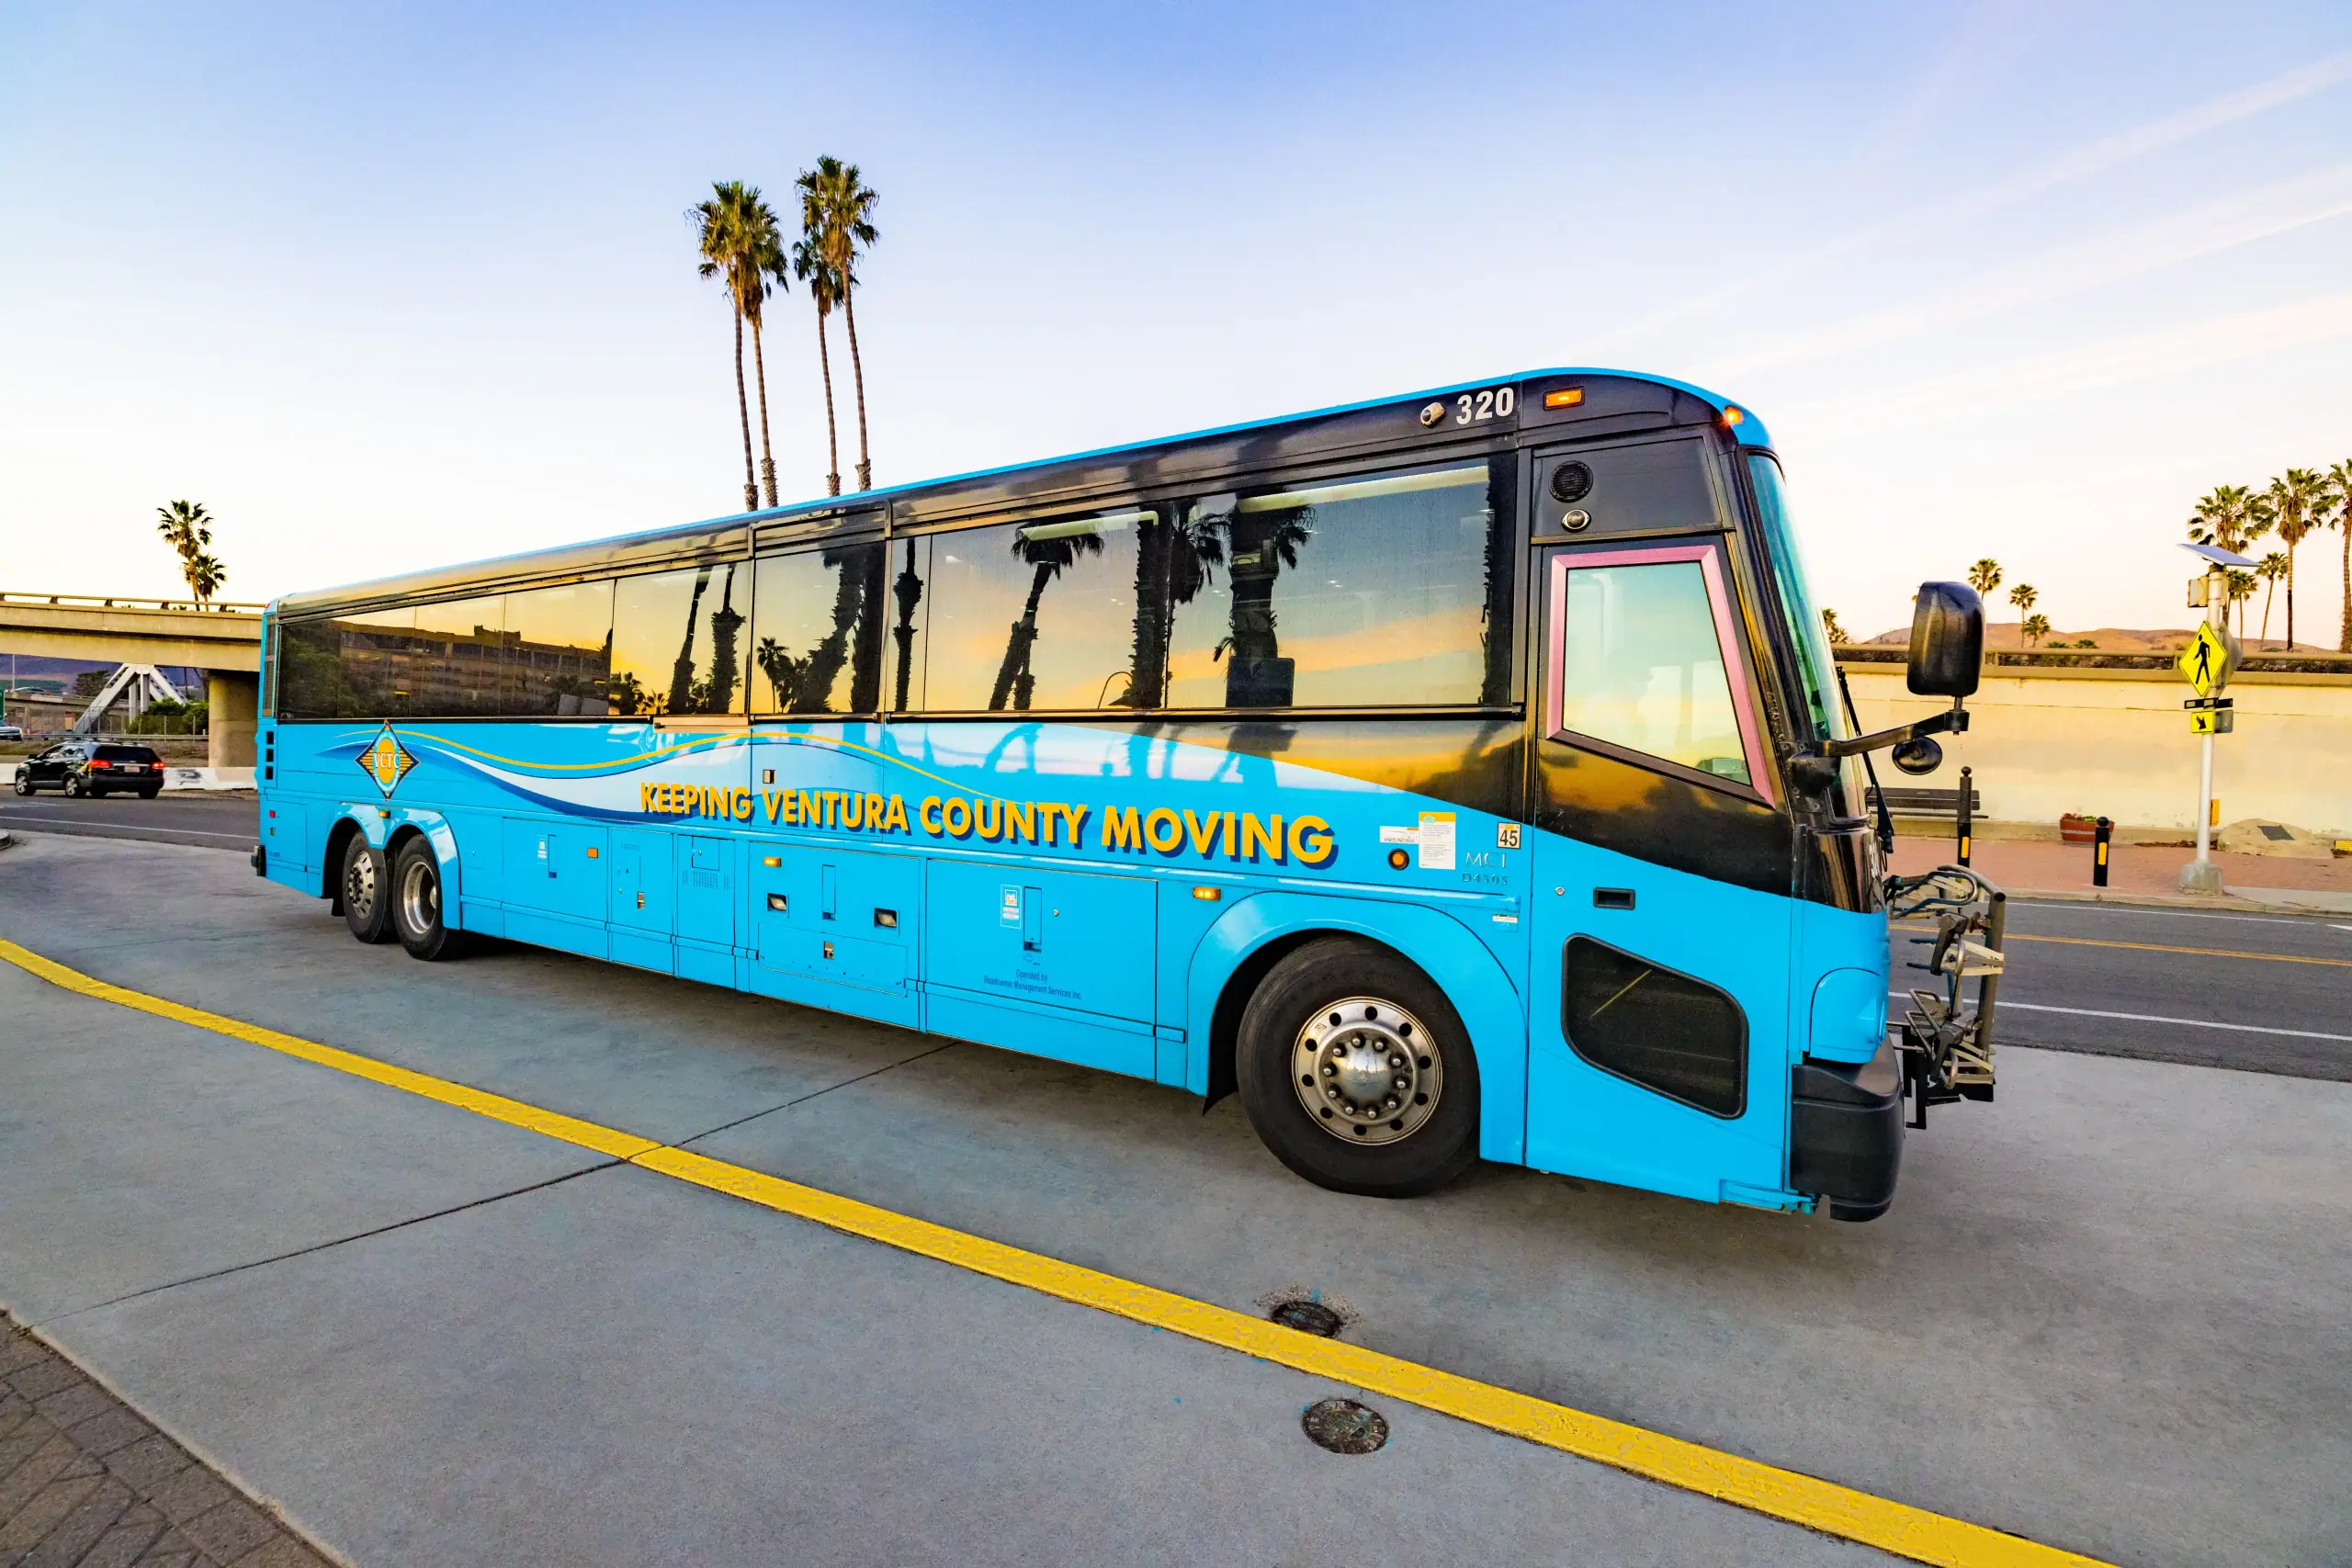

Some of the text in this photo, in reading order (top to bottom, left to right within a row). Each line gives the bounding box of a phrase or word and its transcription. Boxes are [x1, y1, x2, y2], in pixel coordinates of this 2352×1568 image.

[1456, 387, 1514, 425] 320
[373, 752, 400, 769] VCTC
[640, 782, 1334, 864] KEEPING VENTURA COUNTY MOVING
[1499, 829, 1519, 847] 45
[1465, 852, 1507, 869] MCI
[1463, 873, 1508, 885] D4505
[1016, 969, 1047, 984] Operated by
[984, 976, 1012, 988] Roadrunner
[1014, 981, 1046, 994] Management
[1048, 986, 1070, 998] Services
